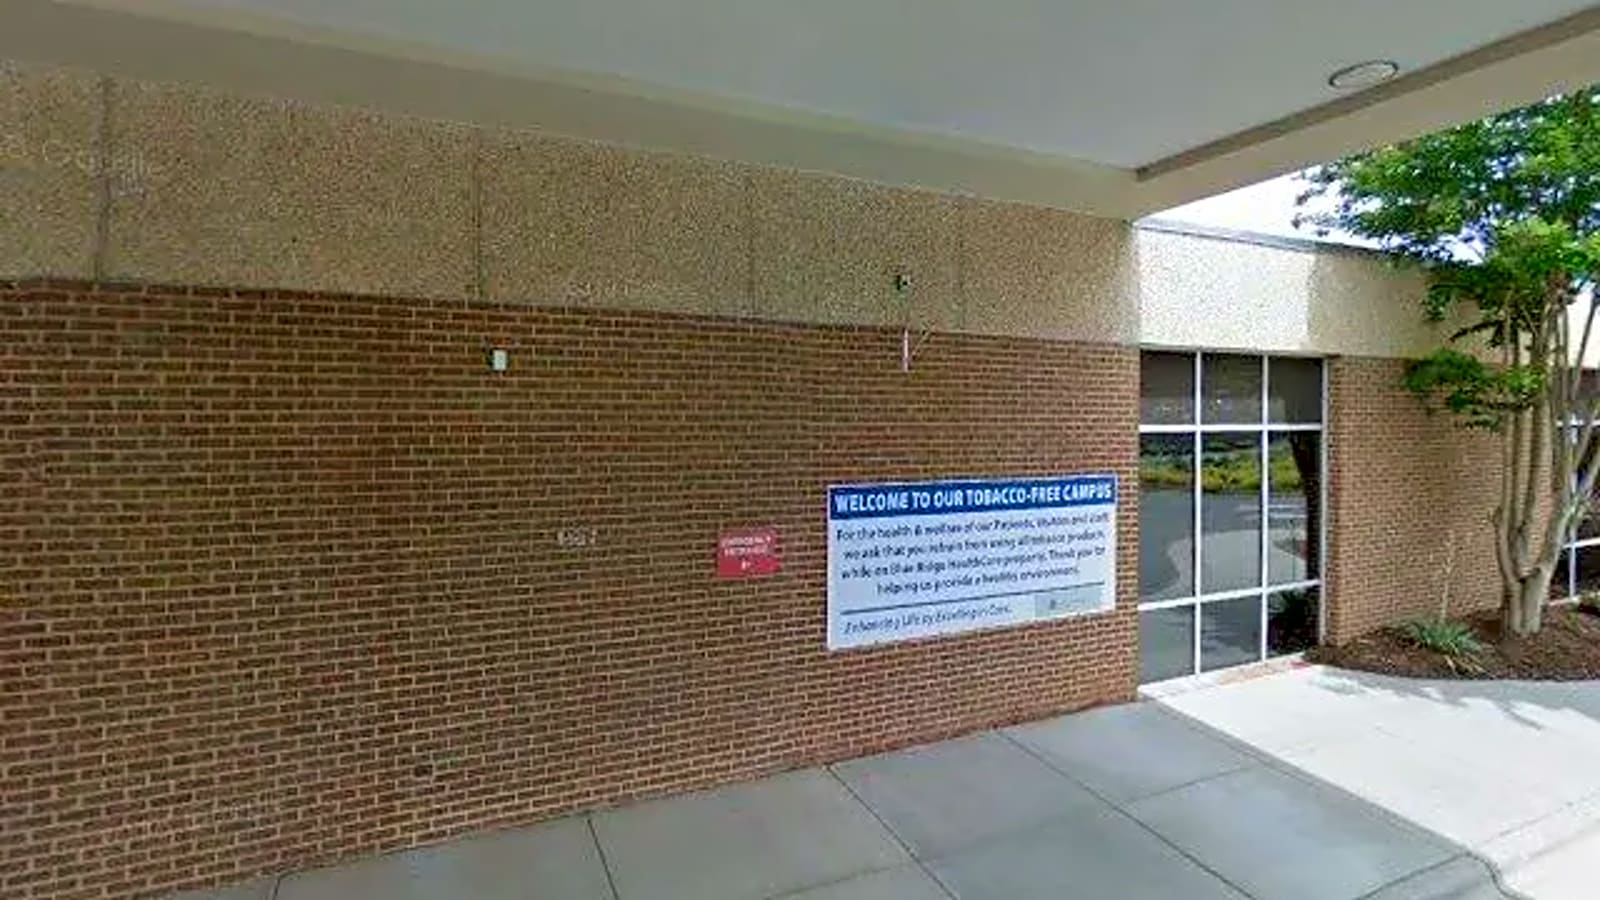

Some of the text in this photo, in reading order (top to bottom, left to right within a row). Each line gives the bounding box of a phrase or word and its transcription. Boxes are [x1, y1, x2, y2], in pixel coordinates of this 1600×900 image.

[835, 484, 1111, 512] WELCOME TO OUR TOBACCO-FREE CAMPUS
[837, 528, 854, 540] For
[857, 526, 875, 539] the
